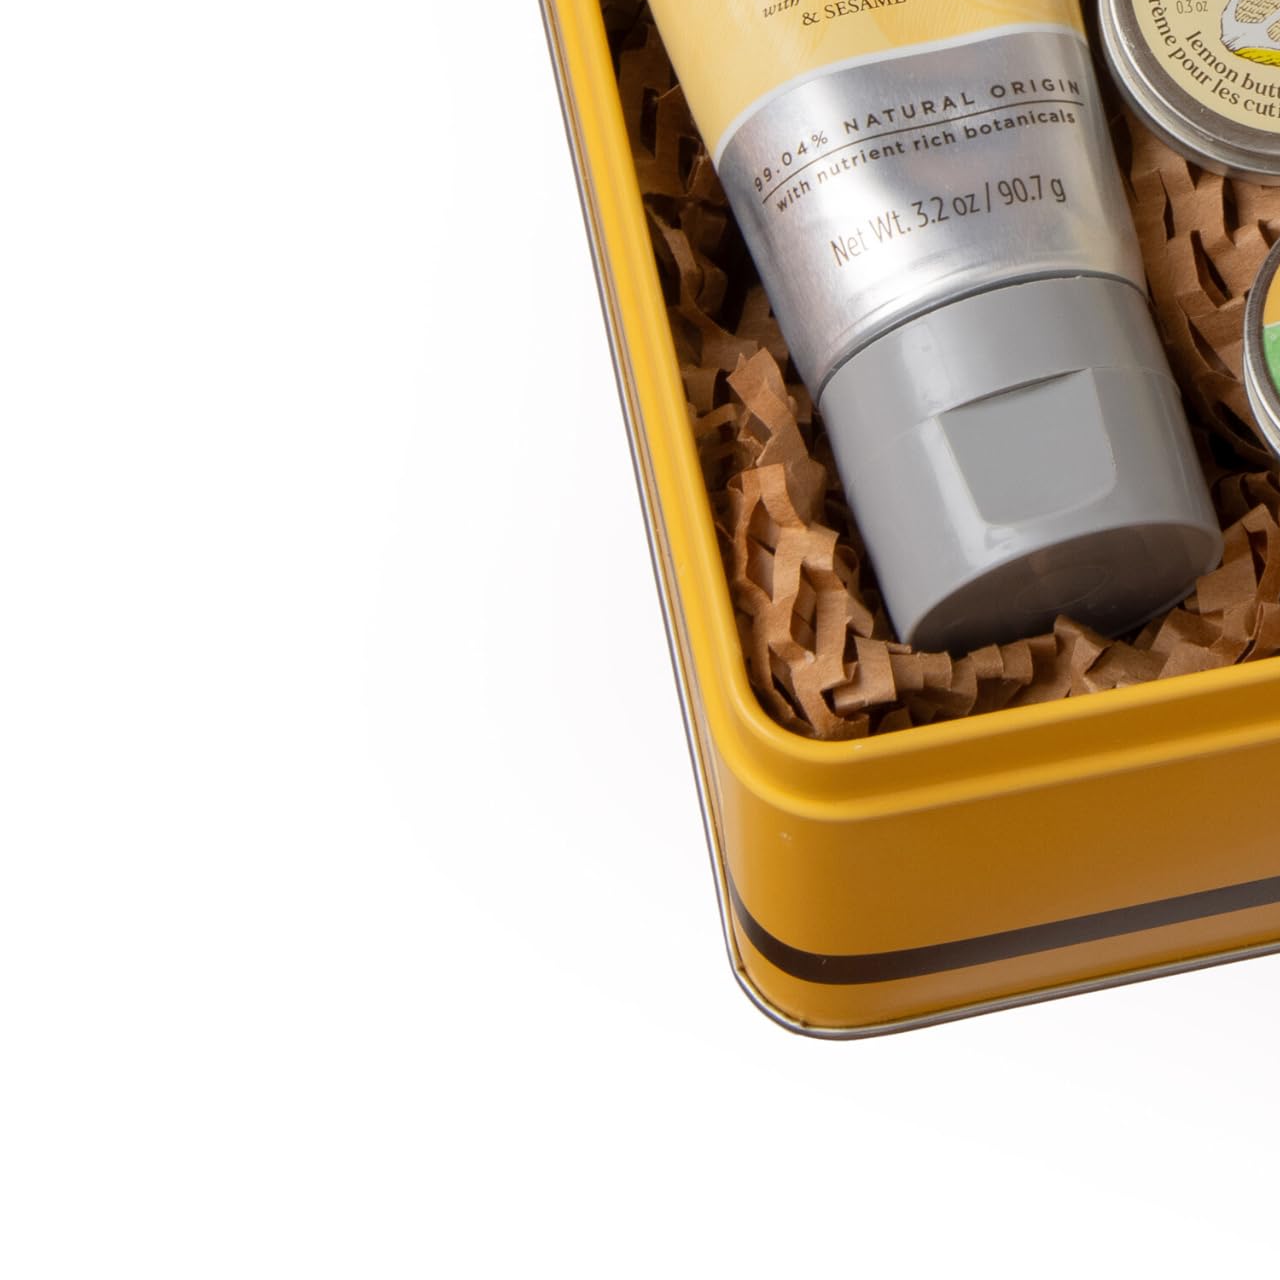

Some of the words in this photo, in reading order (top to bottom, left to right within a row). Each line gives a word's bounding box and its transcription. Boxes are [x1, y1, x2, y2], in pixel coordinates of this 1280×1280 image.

[802, 10, 821, 26] &
[1176, 0, 1194, 15] 0.3
[1194, 0, 1208, 14] oz
[1168, 46, 1212, 88] pour
[1212, 80, 1240, 106] les
[1185, 30, 1239, 82] lemon
[753, 132, 829, 194] 99.04%
[843, 92, 976, 135] NATURAL
[989, 78, 1082, 99] ORIGIN
[776, 179, 812, 213] with
[816, 140, 906, 183] nutrient
[913, 130, 956, 153] rich
[965, 110, 1076, 140] botanicals
[829, 228, 869, 267] Net
[868, 210, 912, 244] Wt.
[911, 196, 950, 229] 3.2
[953, 192, 980, 215] oz
[998, 175, 1043, 206] 90.7
[1051, 180, 1067, 203] g
